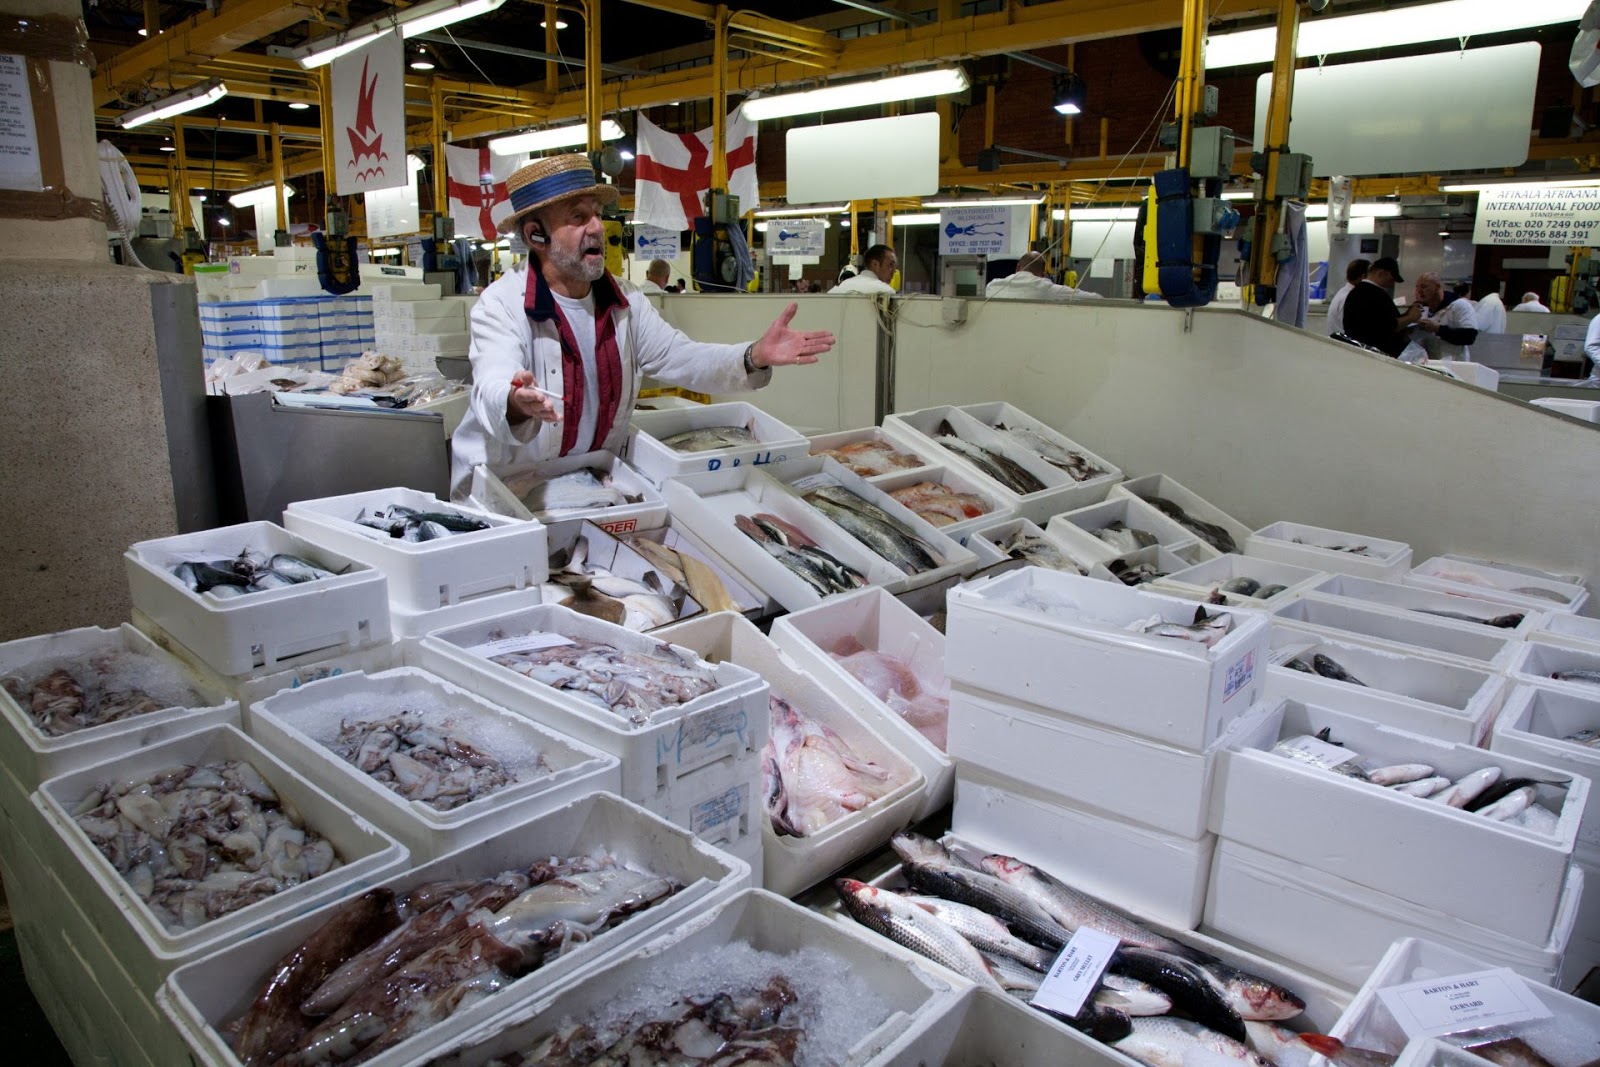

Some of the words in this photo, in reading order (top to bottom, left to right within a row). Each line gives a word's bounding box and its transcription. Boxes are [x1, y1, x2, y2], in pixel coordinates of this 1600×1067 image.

[1497, 190, 1541, 199] AFIKALA
[1543, 189, 1598, 199] AFRIKANA
[1485, 202, 1567, 211] INTERNATIONAL
[1486, 220, 1521, 228] Tel/Fax:
[1524, 220, 1543, 228] 020
[1546, 220, 1571, 228] 7249
[1573, 220, 1600, 228] 0497
[1489, 230, 1513, 238] Mob:
[1515, 230, 1546, 238] 07956
[1549, 230, 1568, 238] 884
[1570, 230, 1589, 239] 391
[1423, 985, 1452, 995] BARTON
[1459, 980, 1479, 988] HART
[1449, 1000, 1484, 1011] GURNARD
